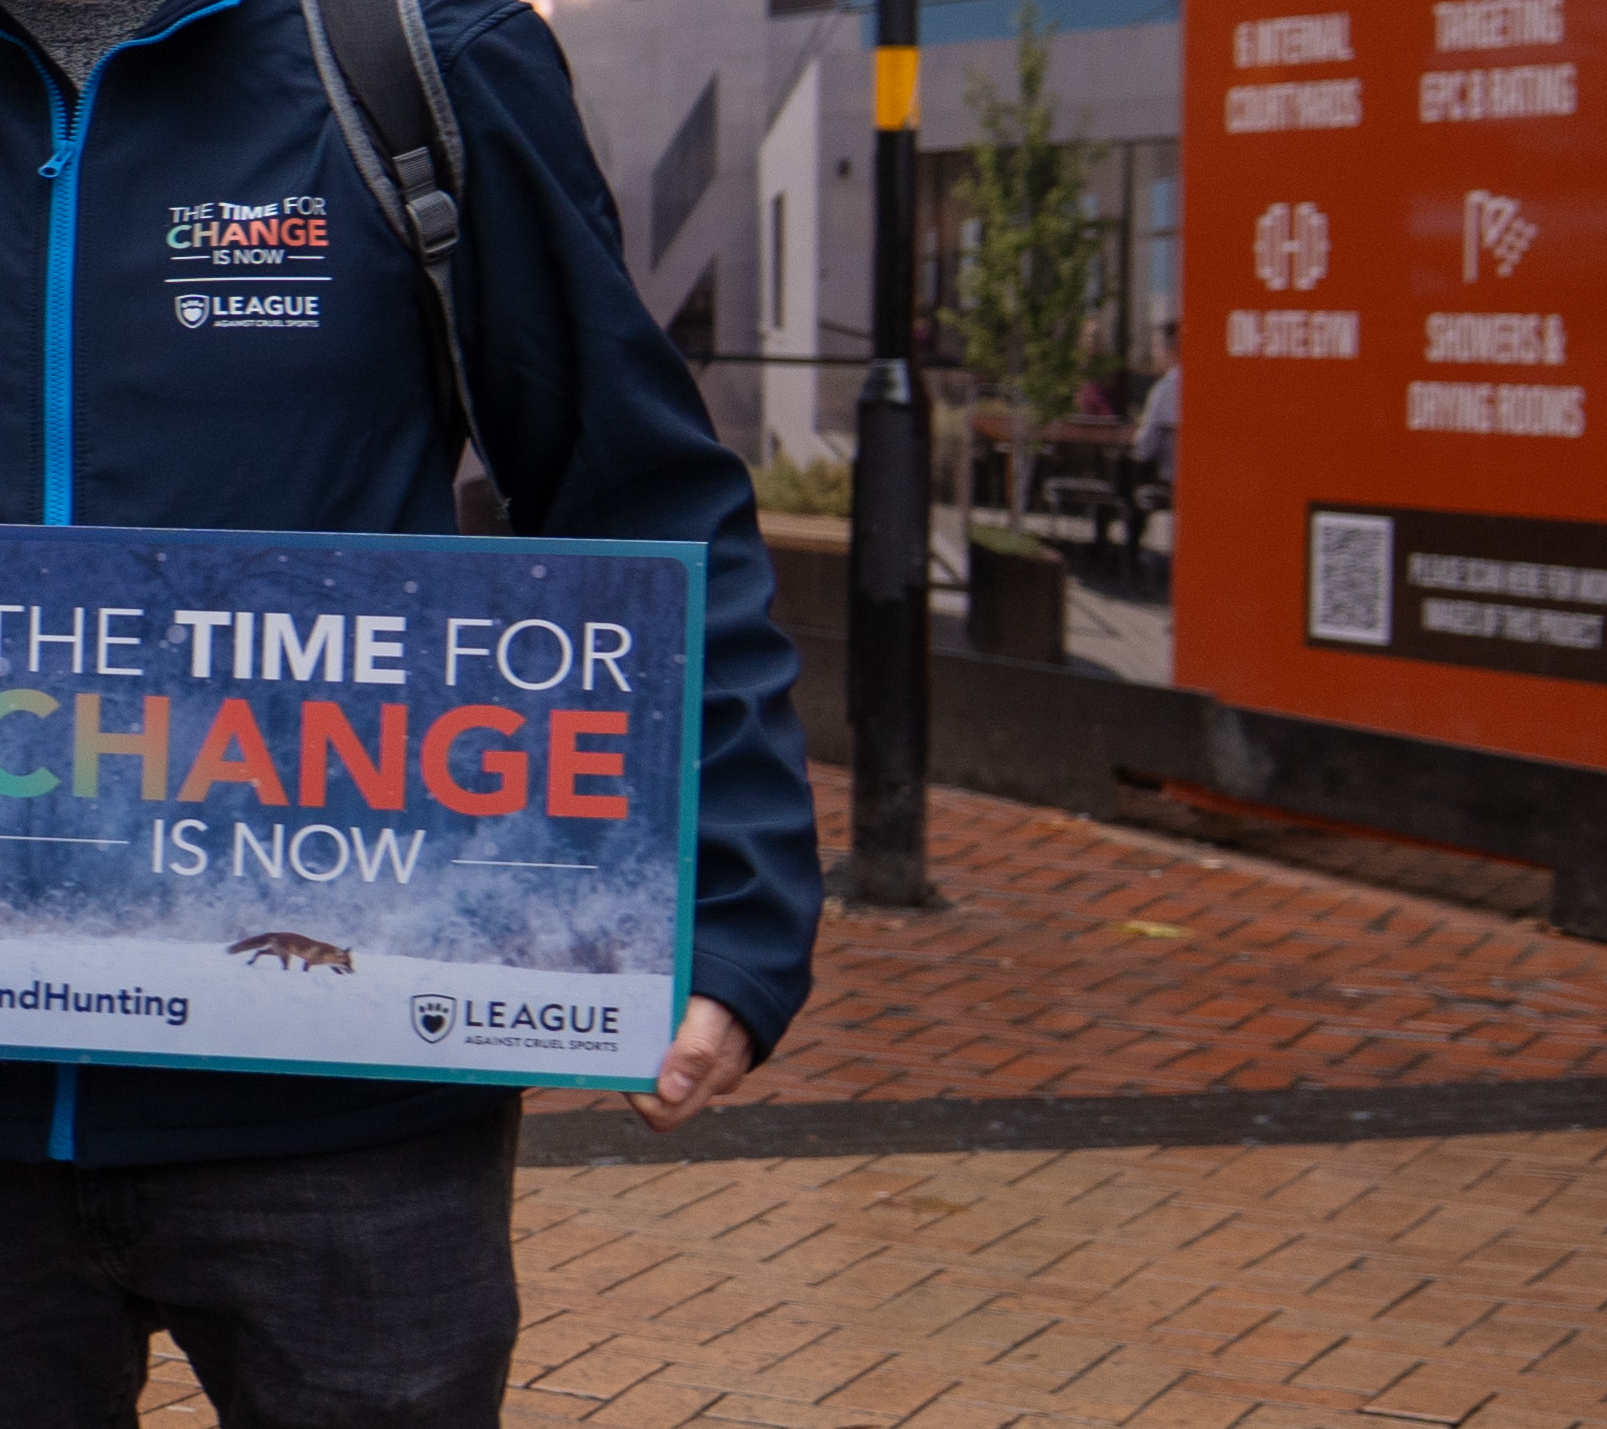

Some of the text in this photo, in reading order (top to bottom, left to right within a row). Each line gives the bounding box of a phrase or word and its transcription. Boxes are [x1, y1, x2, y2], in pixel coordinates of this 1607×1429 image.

[167, 195, 328, 223] THE TIME FOR
[165, 217, 329, 250] CHANGE
[212, 248, 285, 265] IS NOW
[212, 295, 320, 316] LEAGUE
[173, 608, 408, 686] TIME
[444, 617, 635, 694] FOR
[152, 818, 426, 885] IS NOW
[465, 999, 620, 1034] LEAGUE
[465, 1035, 620, 1053] AGAINST CRUEL SPORTS
